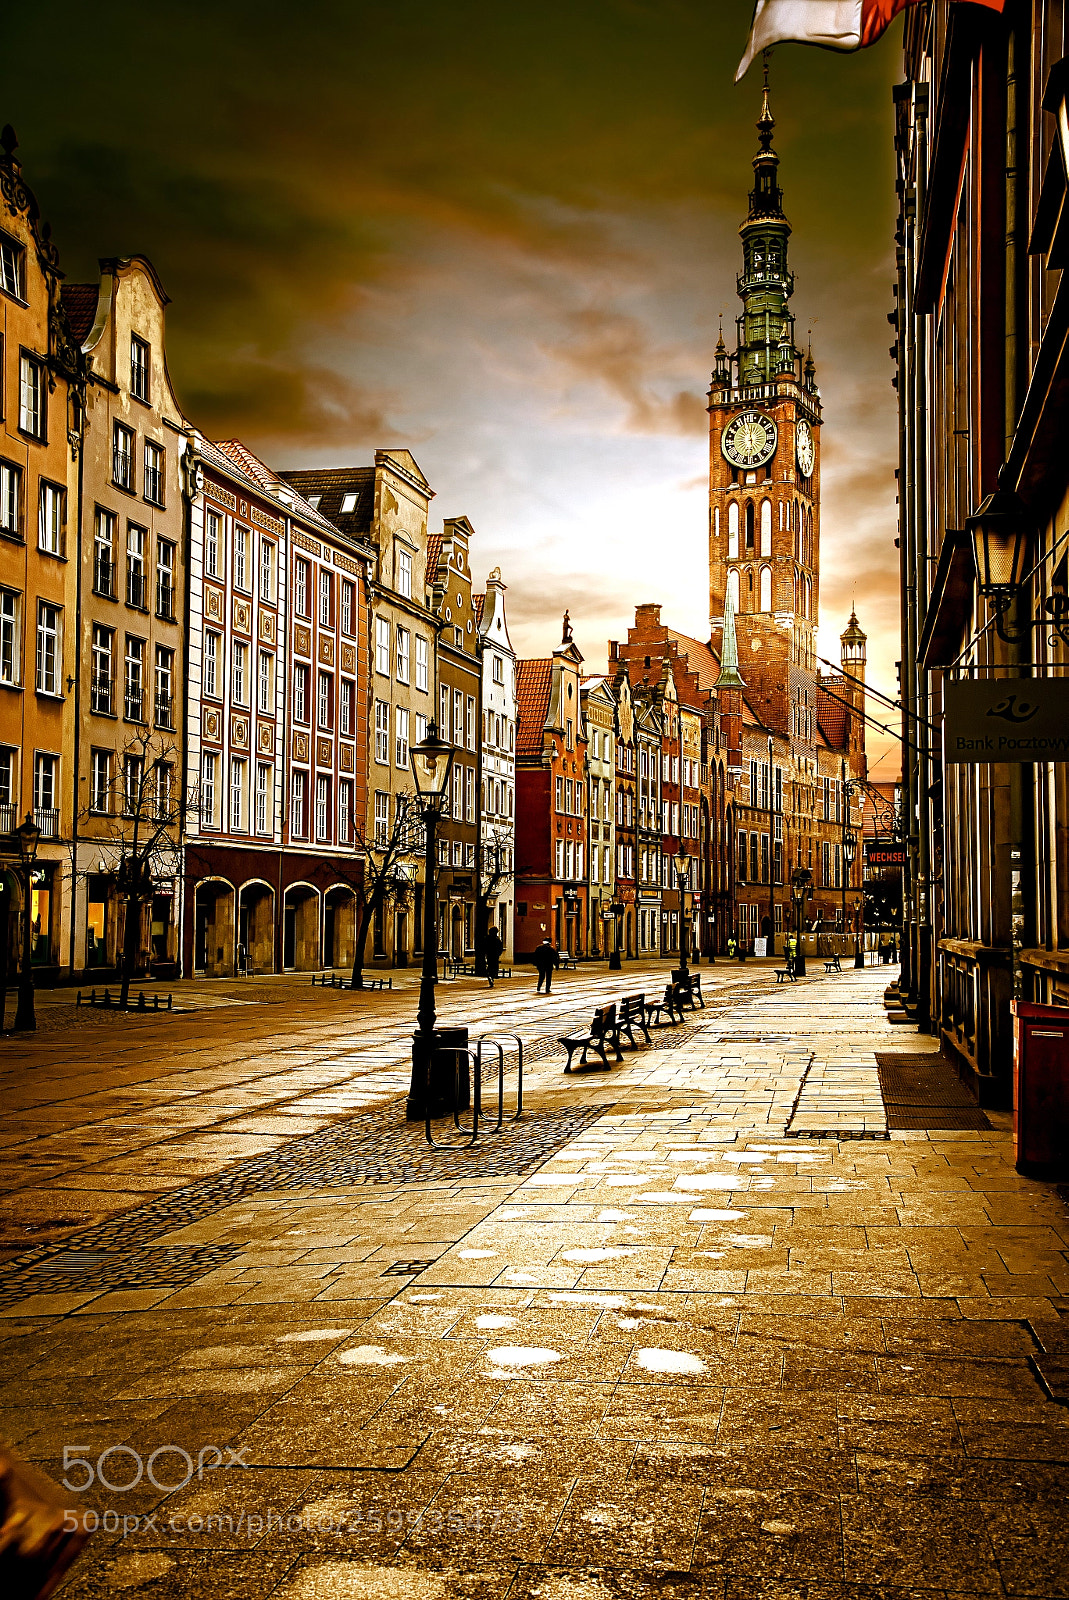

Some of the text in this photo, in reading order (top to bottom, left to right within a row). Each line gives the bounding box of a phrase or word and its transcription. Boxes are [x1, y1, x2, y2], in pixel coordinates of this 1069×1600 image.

[957, 736, 1069, 752] Bank Pocztowy
[868, 852, 906, 862] WECHSEL
